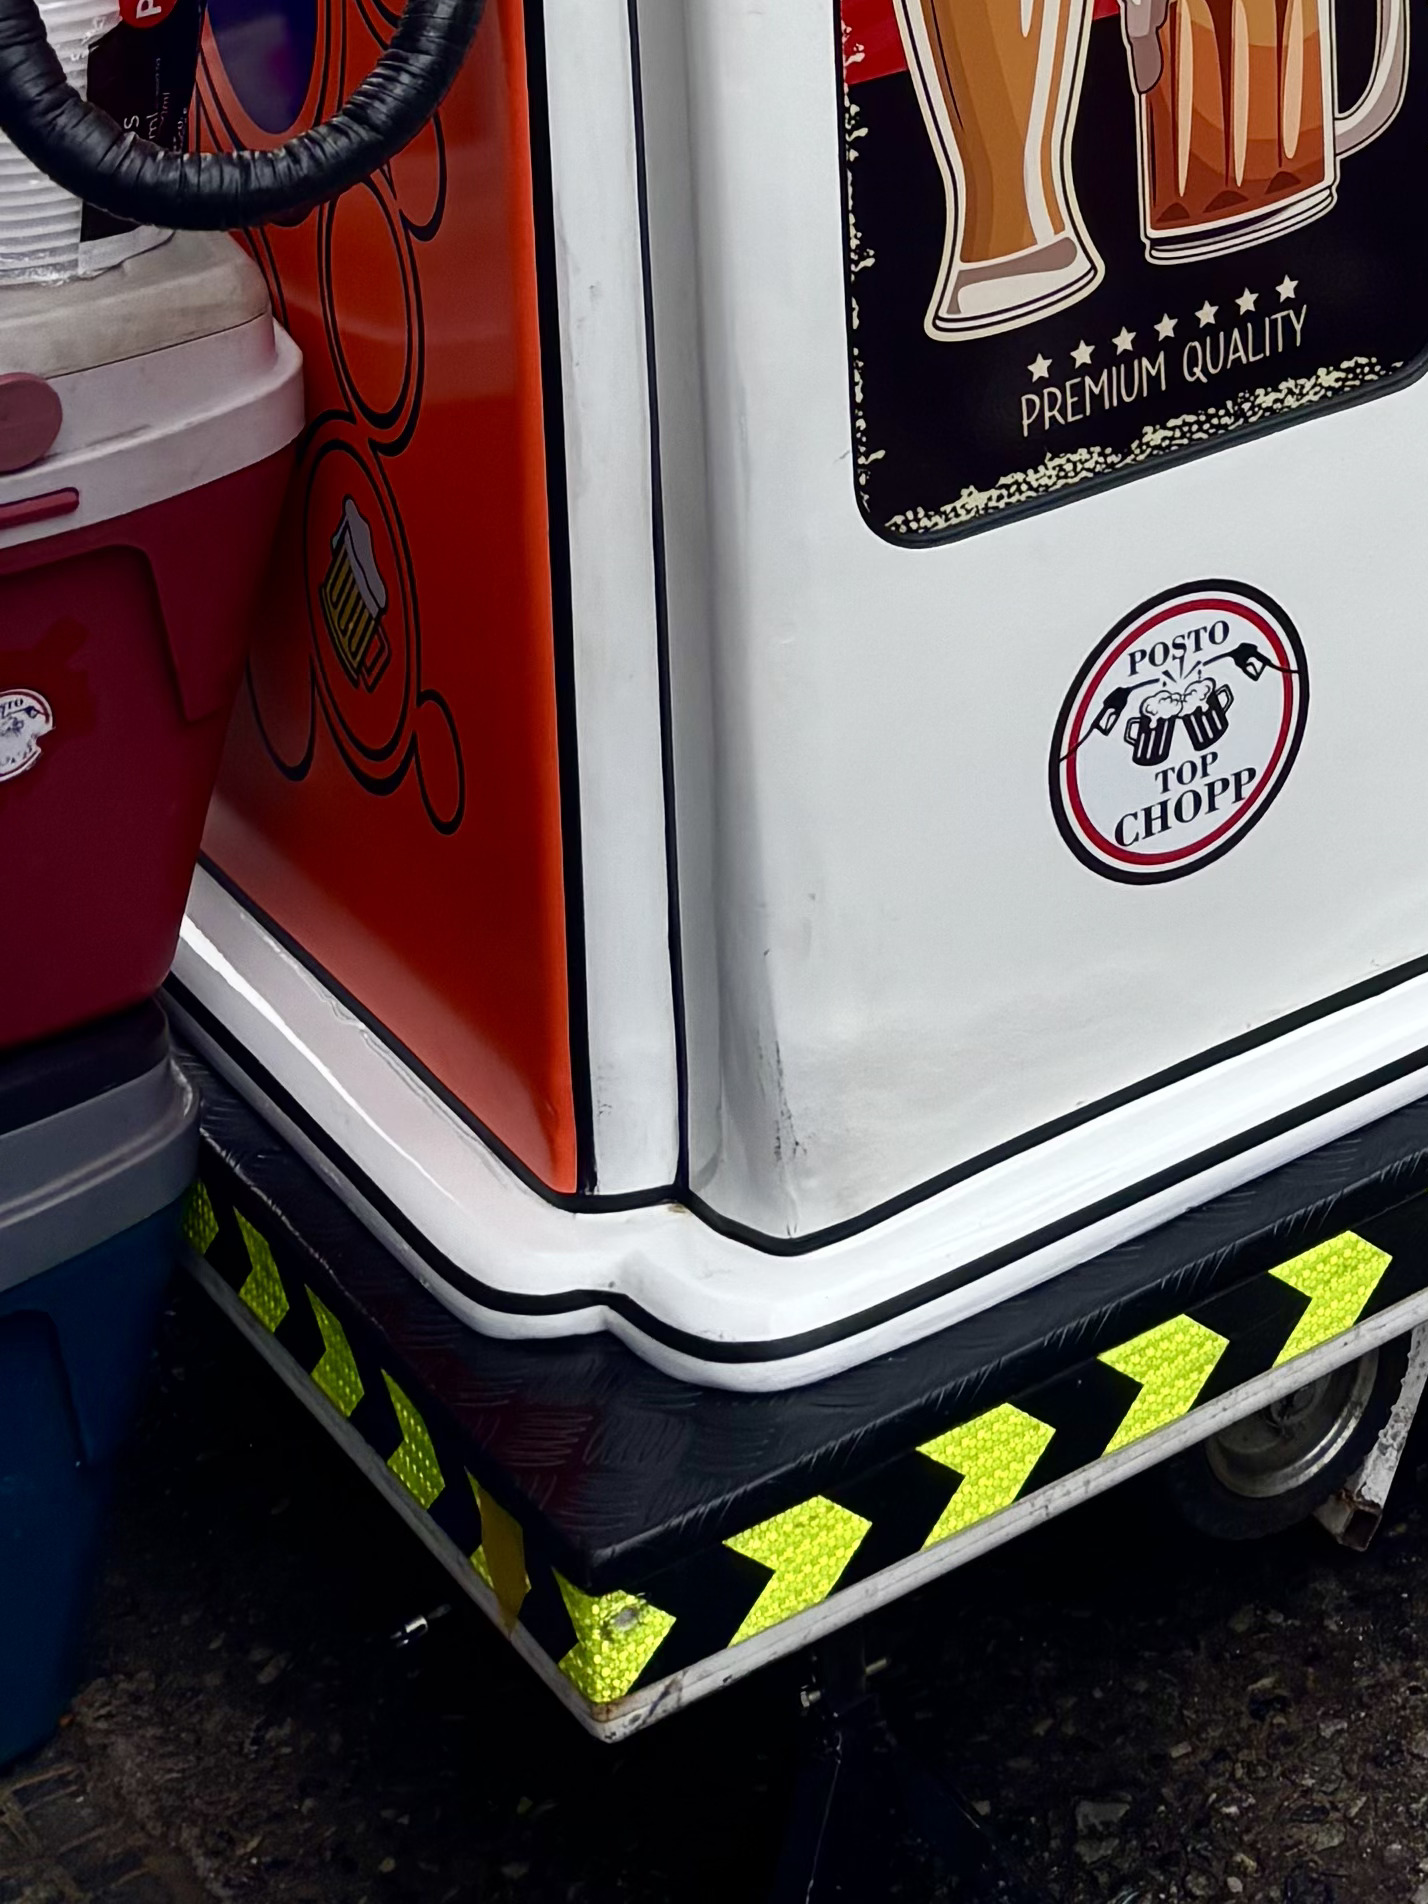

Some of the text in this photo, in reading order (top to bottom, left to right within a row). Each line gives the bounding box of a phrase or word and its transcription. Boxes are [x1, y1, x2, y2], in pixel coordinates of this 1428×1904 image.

[1020, 302, 1309, 438] PREMIUM QUALITY
[1127, 620, 1230, 677] POSTO
[1155, 751, 1219, 794] TOP
[1114, 767, 1257, 847] CHOPP
